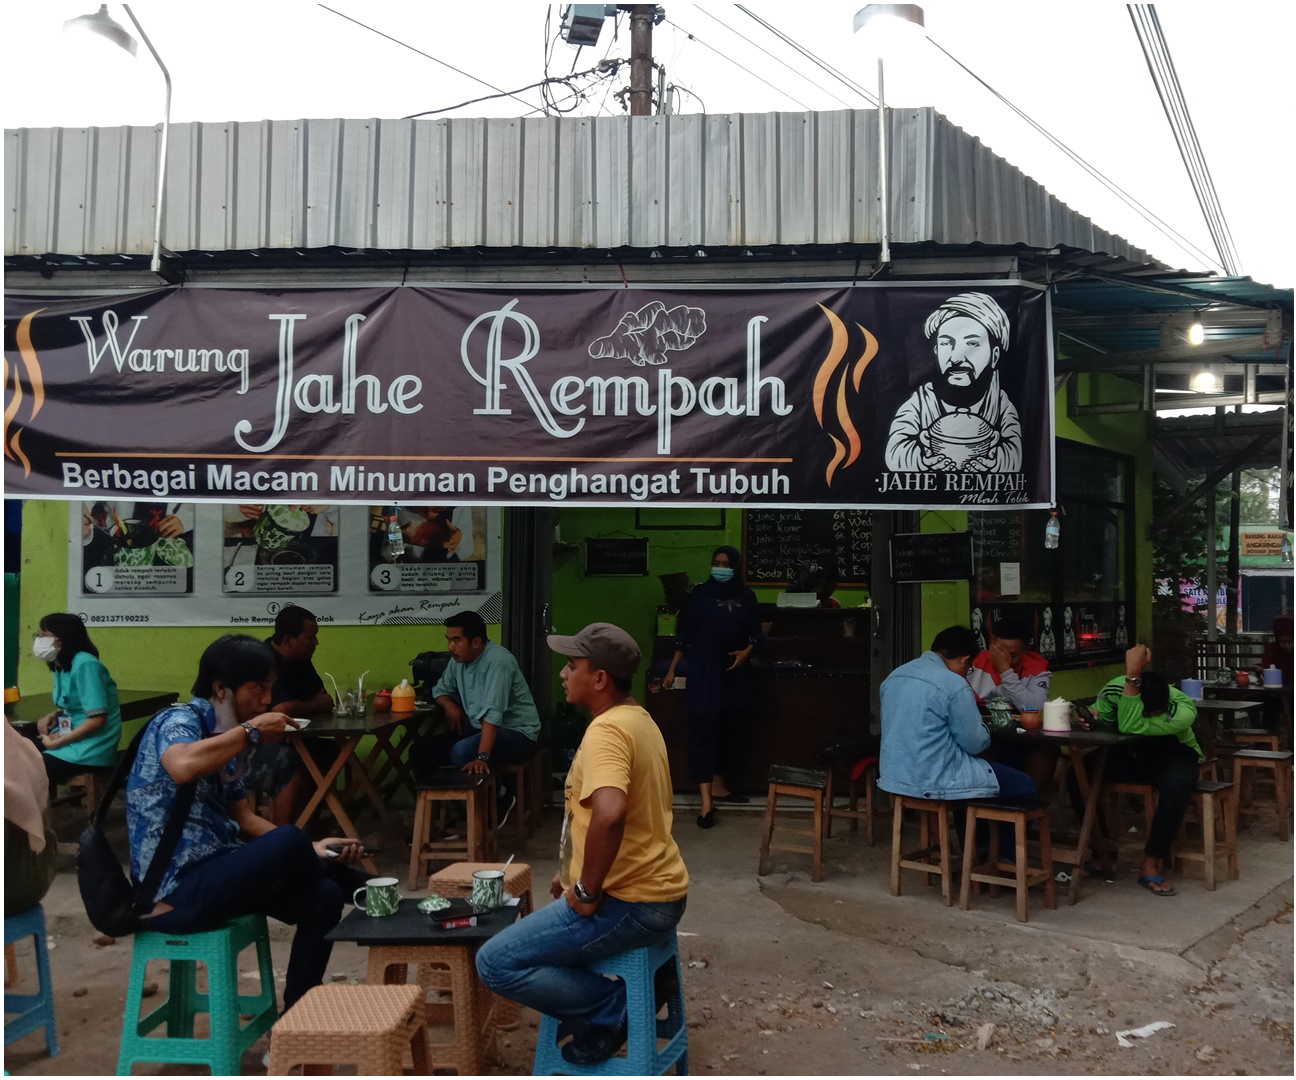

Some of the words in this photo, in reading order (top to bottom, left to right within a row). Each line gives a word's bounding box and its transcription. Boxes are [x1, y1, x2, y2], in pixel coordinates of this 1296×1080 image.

[70, 309, 250, 395] Warung
[234, 313, 425, 454] Jahe
[460, 297, 793, 455] Rempah
[62, 462, 195, 493] Berbagai
[207, 464, 318, 492] Macam
[330, 465, 476, 493] Minuman
[488, 467, 679, 501] Penghangat
[690, 468, 790, 495] Tubuh
[878, 473, 937, 493] JAHE
[944, 473, 1025, 491] REMPAH
[959, 491, 999, 504] Mbah
[96, 572, 103, 587] 1
[234, 571, 245, 586] 2
[380, 569, 391, 585] 3
[756, 567, 783, 578] Soda
[419, 598, 461, 612] Rempah
[91, 615, 149, 623] 082137190225
[230, 616, 249, 624] Jahe
[315, 615, 334, 623] olok
